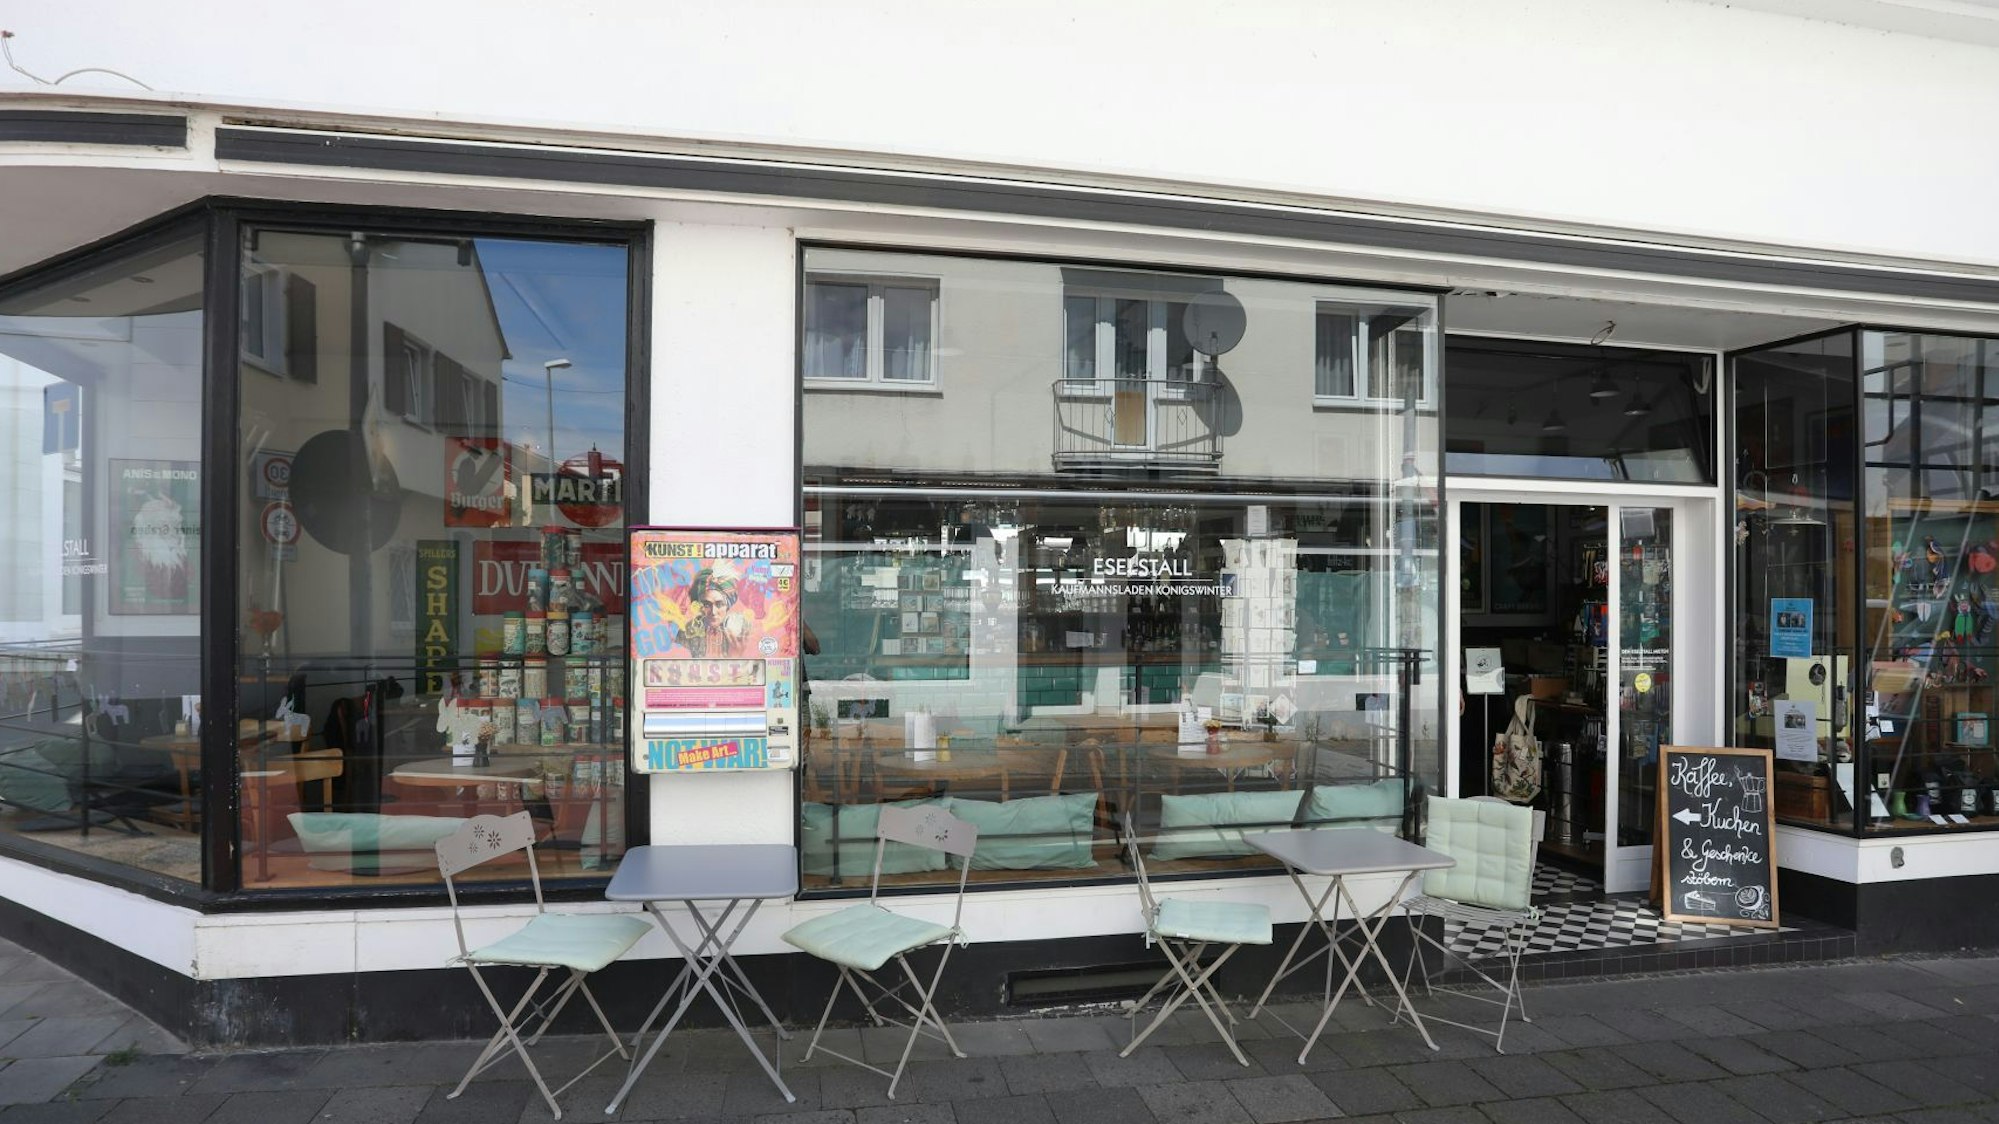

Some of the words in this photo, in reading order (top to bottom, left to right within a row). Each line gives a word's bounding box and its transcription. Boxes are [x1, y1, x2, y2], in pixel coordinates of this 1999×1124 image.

[705, 543, 777, 558] apparat
[1094, 558, 1192, 577] ESELSTALL
[1051, 584, 1154, 596] KAUFMANNSLADEN
[1155, 583, 1232, 596] KÖNIGSWINTER
[679, 748, 710, 764] Make
[1700, 798, 1762, 839] Kuchen
[1681, 838, 1698, 860] &
[1692, 839, 1762, 872] Geschenke
